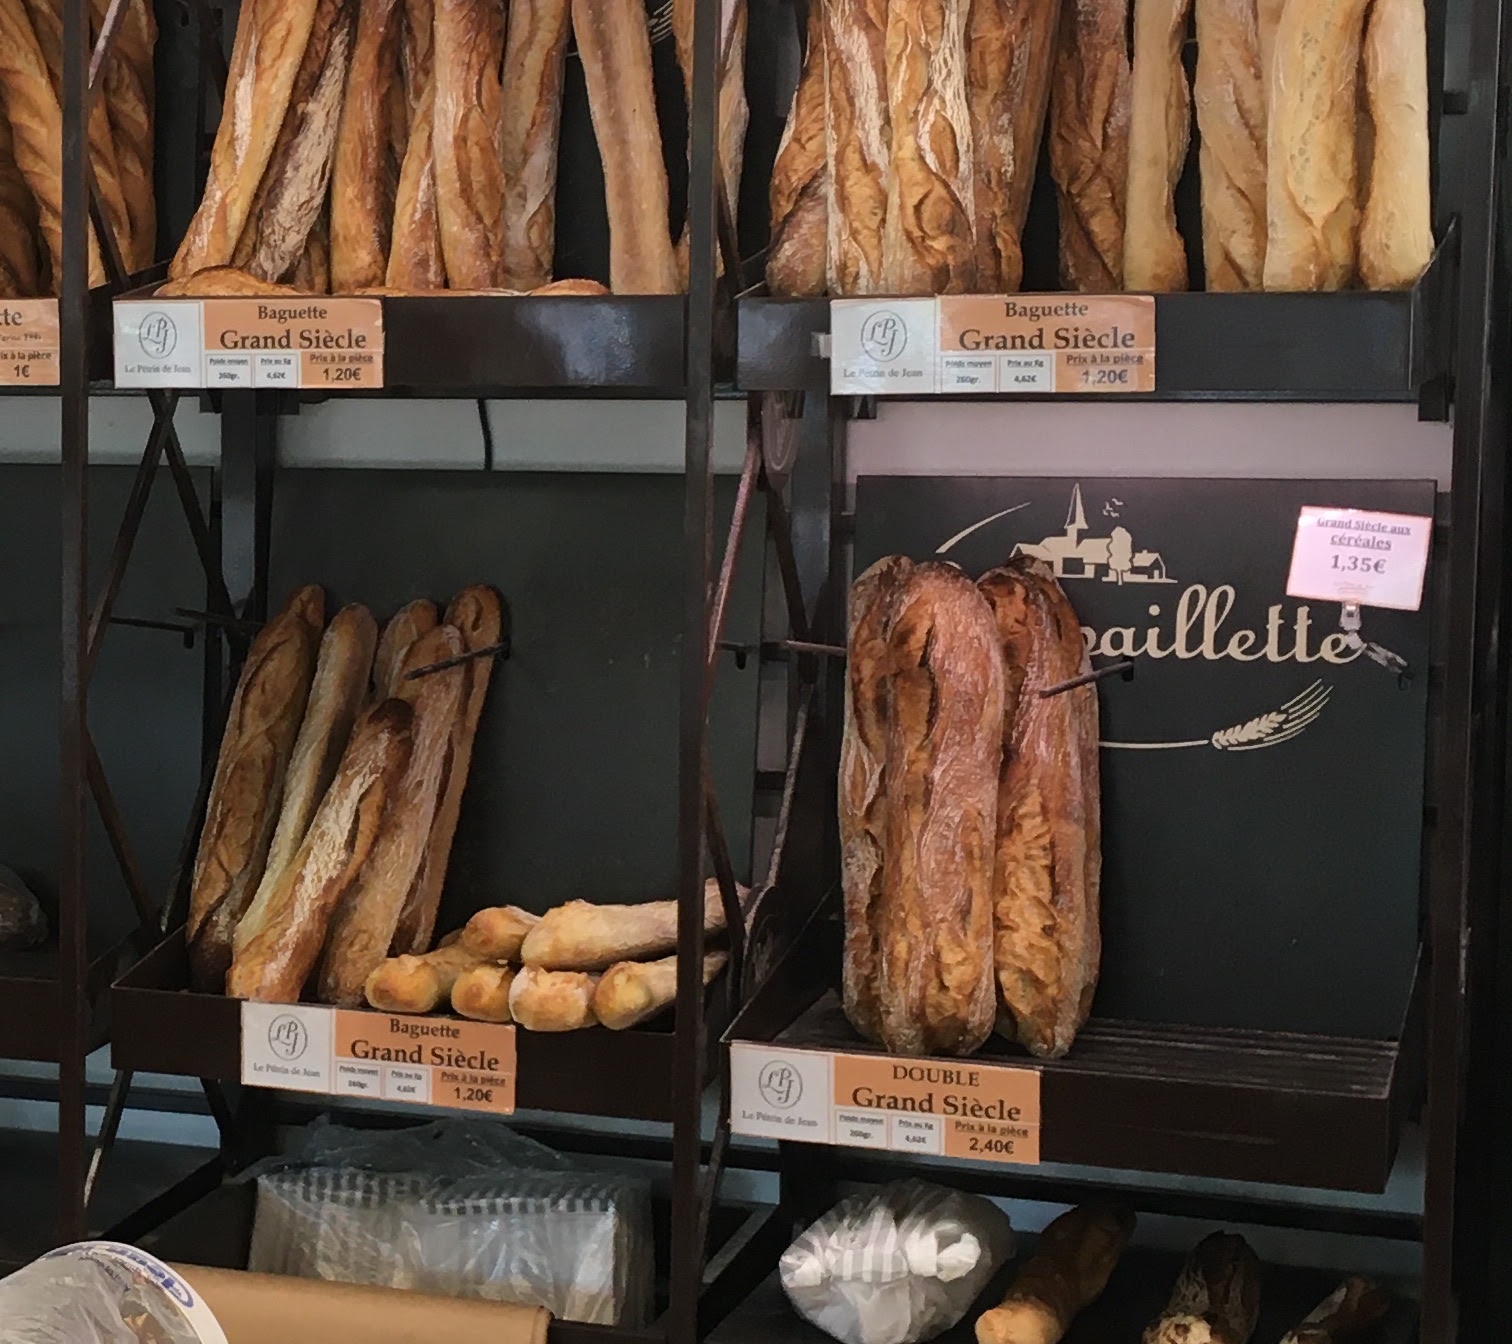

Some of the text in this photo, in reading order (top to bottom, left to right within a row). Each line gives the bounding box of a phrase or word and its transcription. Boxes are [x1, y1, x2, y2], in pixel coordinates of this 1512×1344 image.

[258, 305, 328, 323] Baguette
[1004, 302, 1089, 320] Baguette
[220, 328, 367, 350] Grand Siècle
[959, 327, 1136, 351] Grand Siècle
[1066, 353, 1087, 364] Prix
[1100, 353, 1110, 364] la
[1113, 353, 1143, 366] pièce
[13, 364, 31, 378] 1€
[322, 367, 362, 383] 1,20€
[1082, 368, 1128, 385] 1,20€
[1390, 525, 1411, 536] aux
[1330, 533, 1392, 551] céréales
[1331, 554, 1387, 574] 1,35€
[389, 1018, 461, 1039] Baguette
[351, 1040, 500, 1071] Grand Siècle
[892, 1065, 980, 1087] DOUBLE
[454, 1086, 493, 1103] 1,20€
[852, 1087, 1021, 1122] Grand Siècle
[955, 1120, 975, 1131] Prix
[969, 1136, 1015, 1155] 2,40€
